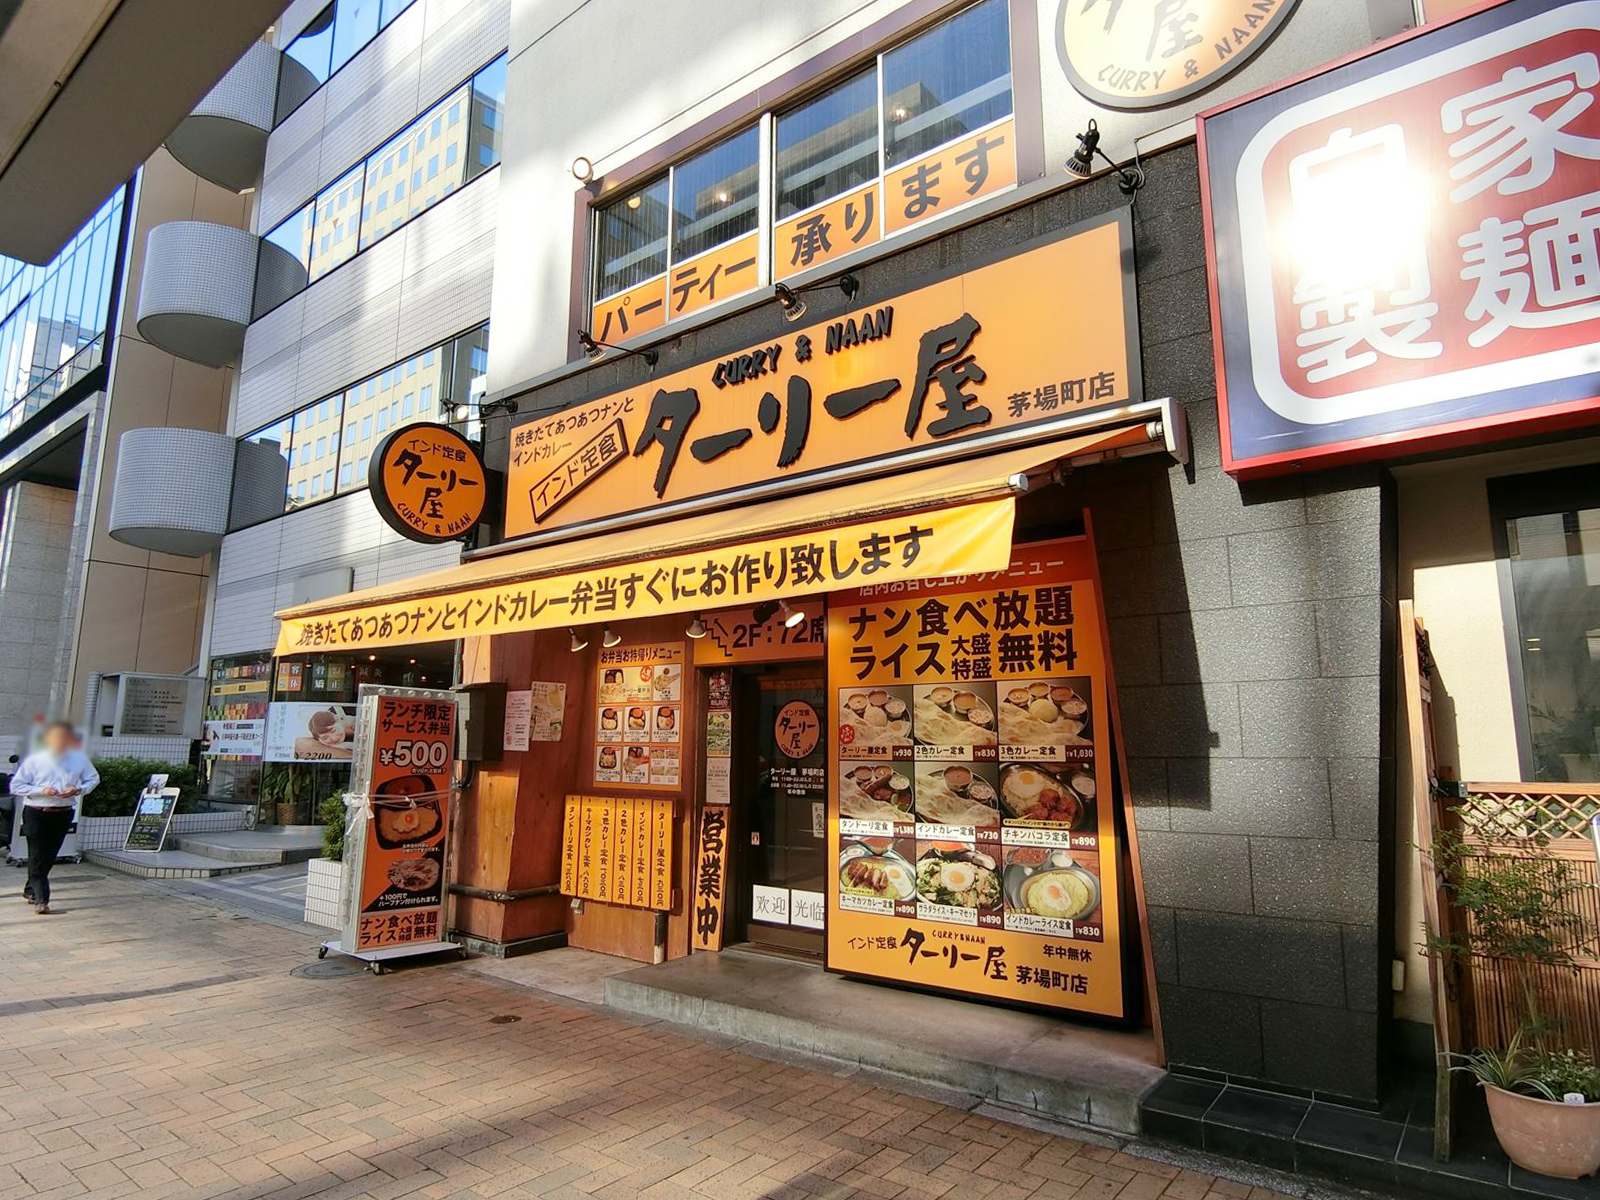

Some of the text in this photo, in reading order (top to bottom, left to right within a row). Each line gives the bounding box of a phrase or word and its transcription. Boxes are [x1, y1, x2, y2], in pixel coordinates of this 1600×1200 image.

[1097, 0, 1276, 92] CURRY & NAAN
[711, 306, 894, 390] CURRY & NAAN
[633, 312, 992, 500] ターリー屋
[1007, 371, 1115, 418] 茅場町店
[514, 396, 635, 449] 焼きたてあつあつナンと
[408, 439, 467, 463] インド定食
[513, 441, 573, 468] インドカレー
[536, 433, 619, 507] インド定食
[419, 487, 444, 520] 屋
[397, 502, 429, 530] CURRY
[434, 524, 442, 535] &
[295, 525, 934, 647] 焼きたてあつあつナンとインドカレー弁当すぐにお作り致します
[849, 586, 1074, 642] ナン食べ放題
[850, 629, 1077, 681] ライス 大盛 無料
[951, 656, 992, 680] 特盛
[384, 702, 452, 721] ランチ限定
[382, 719, 451, 735] サービス弁当
[380, 739, 449, 768] ¥500
[841, 745, 888, 755] ターリー屋定食
[916, 746, 965, 755] 2色カレー定食
[1000, 746, 1057, 755] 3色カレー定食
[841, 820, 889, 831] タンドーリ定食
[918, 825, 975, 837] インドカレー定食
[697, 810, 726, 946] 営業中
[756, 894, 787, 916] 欢迎
[360, 911, 438, 931] ナン食べ放題
[1006, 913, 1072, 930] インドカレーライス定食
[360, 929, 397, 946] ライス
[414, 924, 437, 938] 無料
[847, 936, 898, 950] インド定食
[900, 927, 1009, 981] ターリー屋
[1043, 944, 1093, 962] 年中無休
[1016, 965, 1088, 995] 茅場町店
